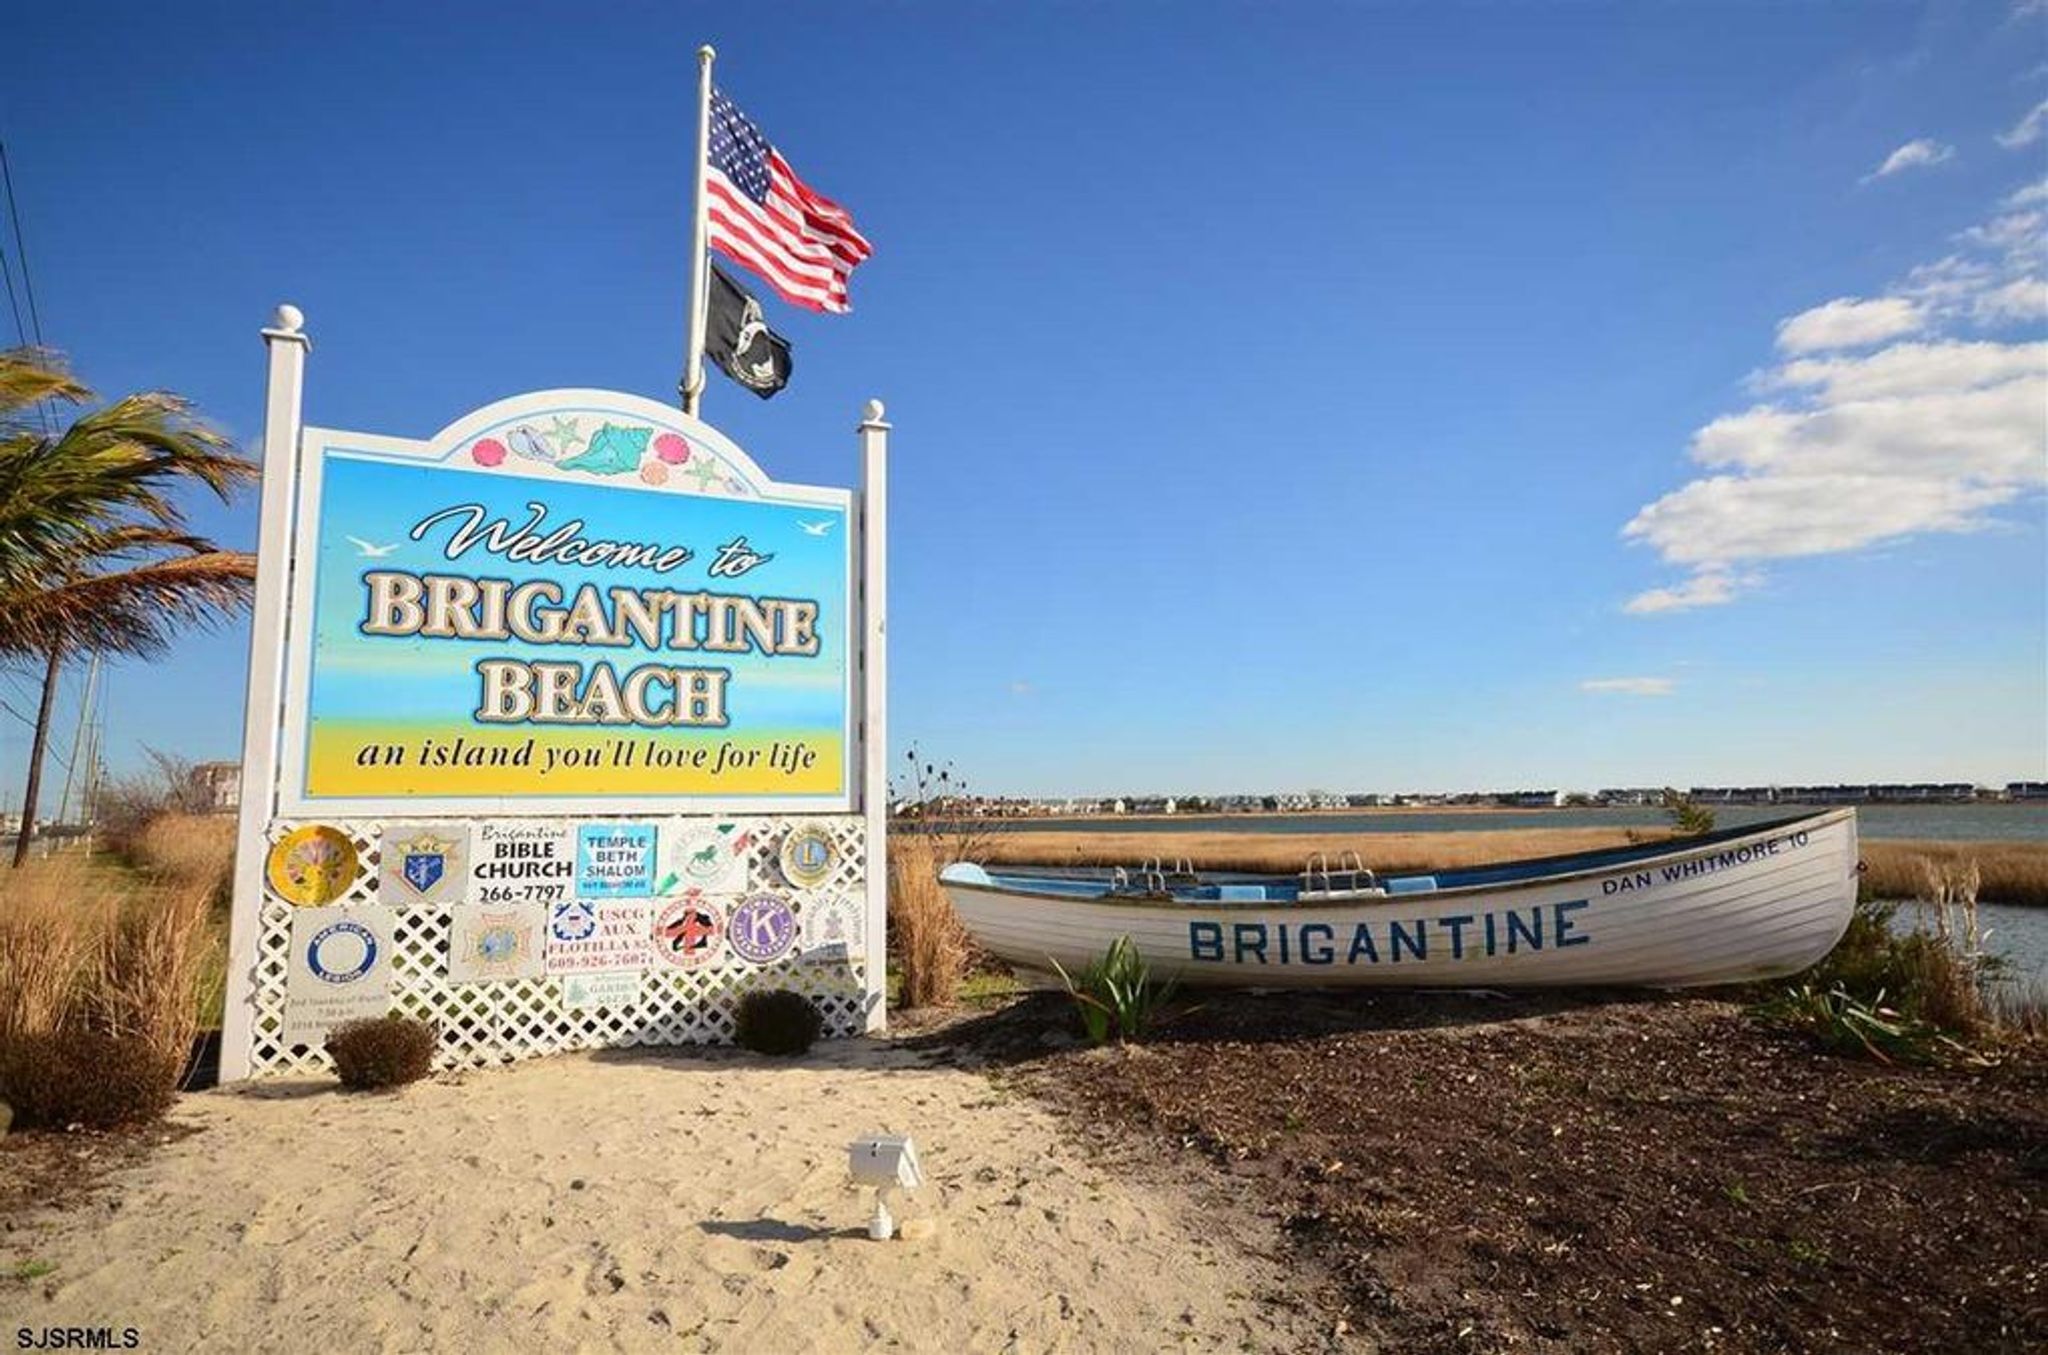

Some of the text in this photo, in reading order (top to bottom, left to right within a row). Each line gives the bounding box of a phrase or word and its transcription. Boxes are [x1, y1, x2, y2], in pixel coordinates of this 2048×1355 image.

[410, 501, 774, 578] Welcome to
[359, 571, 820, 656] BRIGANTINE
[475, 658, 730, 729] BEACH
[357, 738, 816, 775] an island you'll love for life
[495, 842, 554, 859] BIBLE
[587, 836, 647, 849] TEMPLE
[596, 851, 637, 863] BETH
[474, 861, 573, 879] CHURCH
[586, 865, 646, 878] SHALOM
[1602, 831, 1809, 896] DAN WHITMORE 10
[479, 885, 566, 903] 266-7797
[751, 909, 777, 946] K
[1189, 899, 1592, 966] BRIGANTINE
